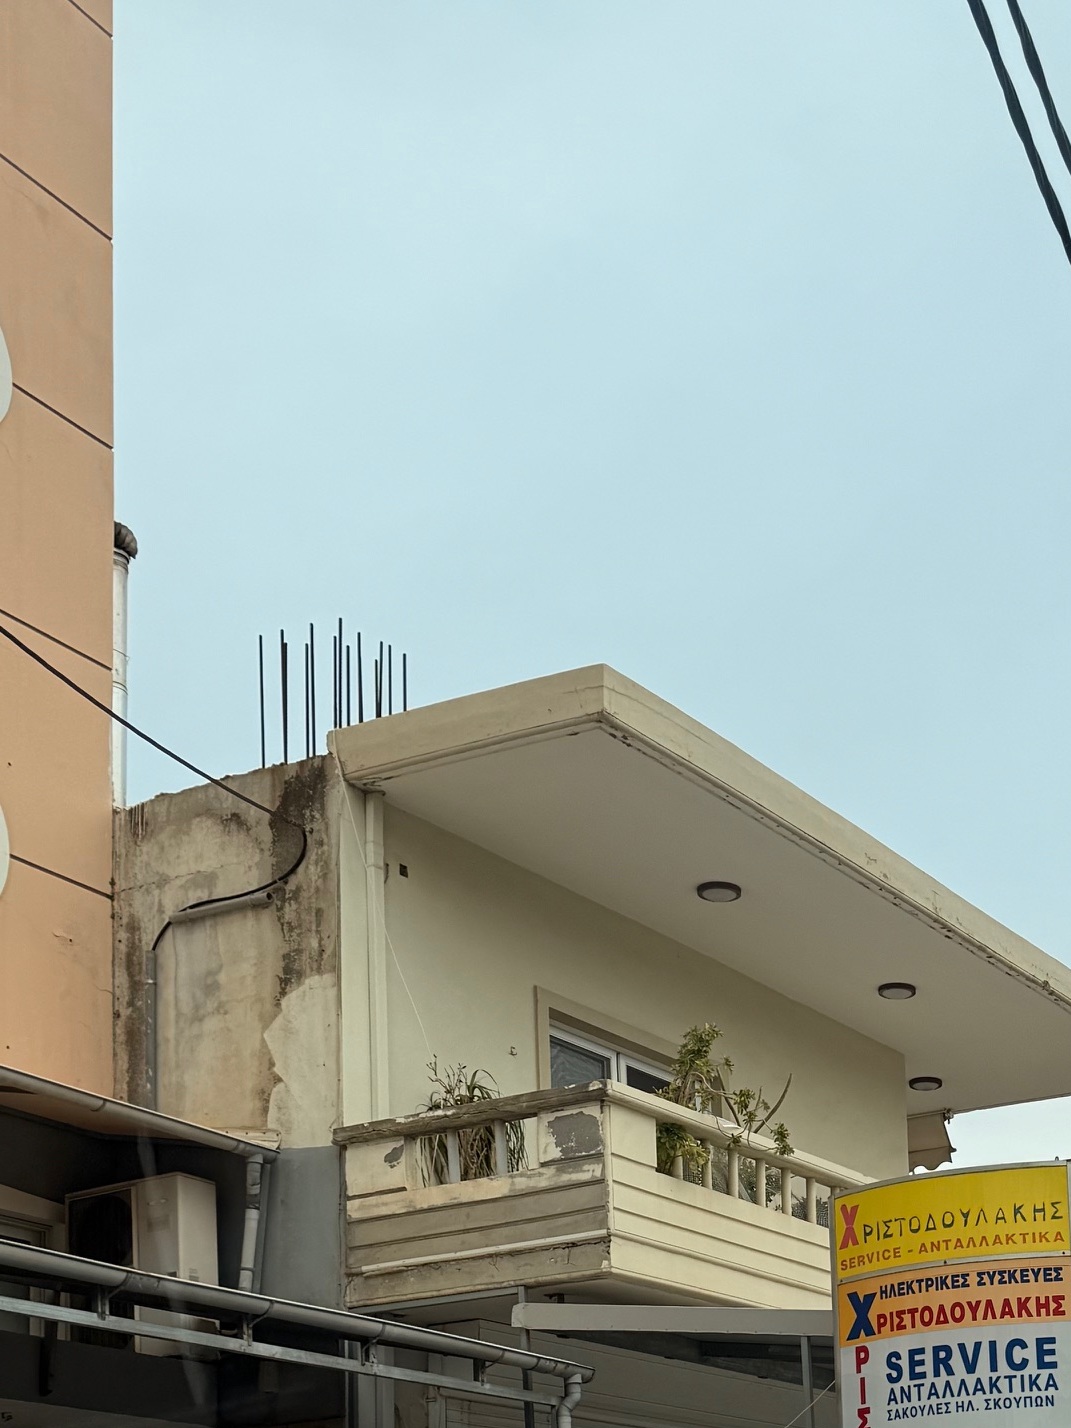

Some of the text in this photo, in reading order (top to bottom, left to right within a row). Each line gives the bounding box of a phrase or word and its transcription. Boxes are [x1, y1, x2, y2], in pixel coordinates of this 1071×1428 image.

[840, 1246, 901, 1271] SERVICE
[918, 1231, 1065, 1255] ΑΝΤΑΛΛΑΚΤΙΚΑ
[879, 1266, 1064, 1300] ΗΛΕΚΤΡΙΚΕΣ ΣΥΣΚΕΥΕΣ
[885, 1337, 1058, 1384] SERVICE
[887, 1373, 1059, 1406] ΑΝΤΑΛΛΑΚΤΙΚΑ
[887, 1394, 1055, 1421] ΣΑΚΟΥΛΕΣ ΗΛ. ΣΚΟΥΠΩΝ
